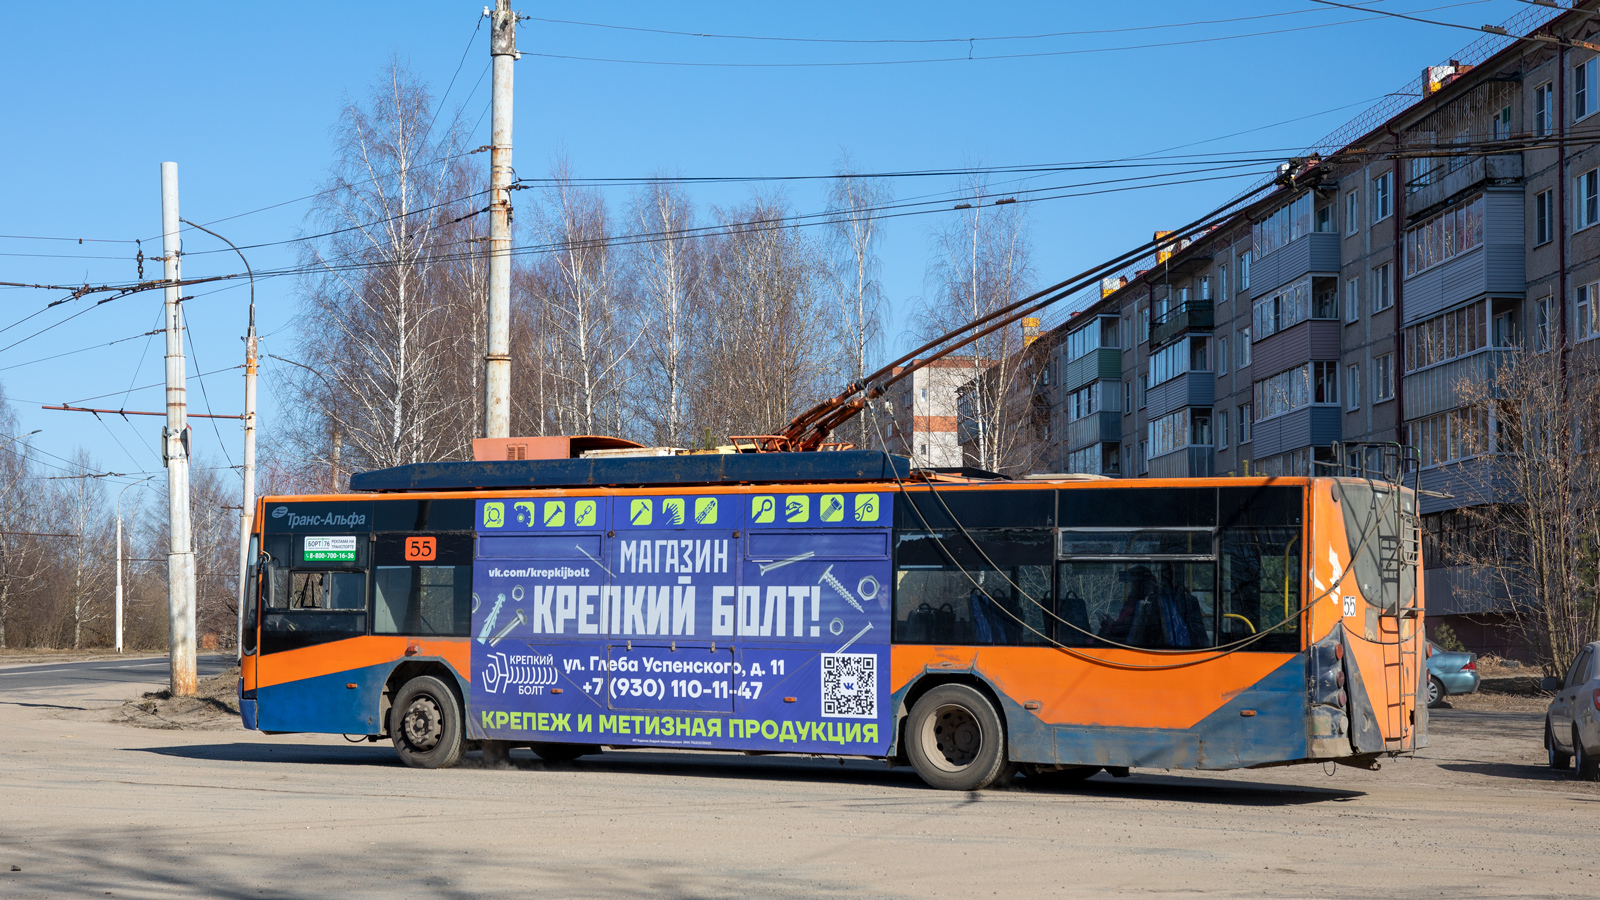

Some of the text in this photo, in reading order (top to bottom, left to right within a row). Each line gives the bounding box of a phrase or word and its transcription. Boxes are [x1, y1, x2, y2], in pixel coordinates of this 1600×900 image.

[287, 512, 366, 529] Транс-Альфа
[410, 541, 432, 557] 55
[619, 539, 728, 574] МАГАЗИН
[488, 567, 590, 579] vk.com/krepkijbolt
[533, 575, 821, 637] КРЕПКИЙ БОЛТ!
[1343, 596, 1356, 616] 55
[510, 654, 553, 665] КРЕПКИЙ
[563, 656, 785, 677] ул. Глеба Успенского, д. 11
[518, 686, 544, 695] БОЛТ
[583, 677, 763, 701] +7 (930) 110-11-47
[482, 711, 879, 745] КРЕПЕЖ И МЕТИЗНАЯ ПРОДУКЦИЯ
